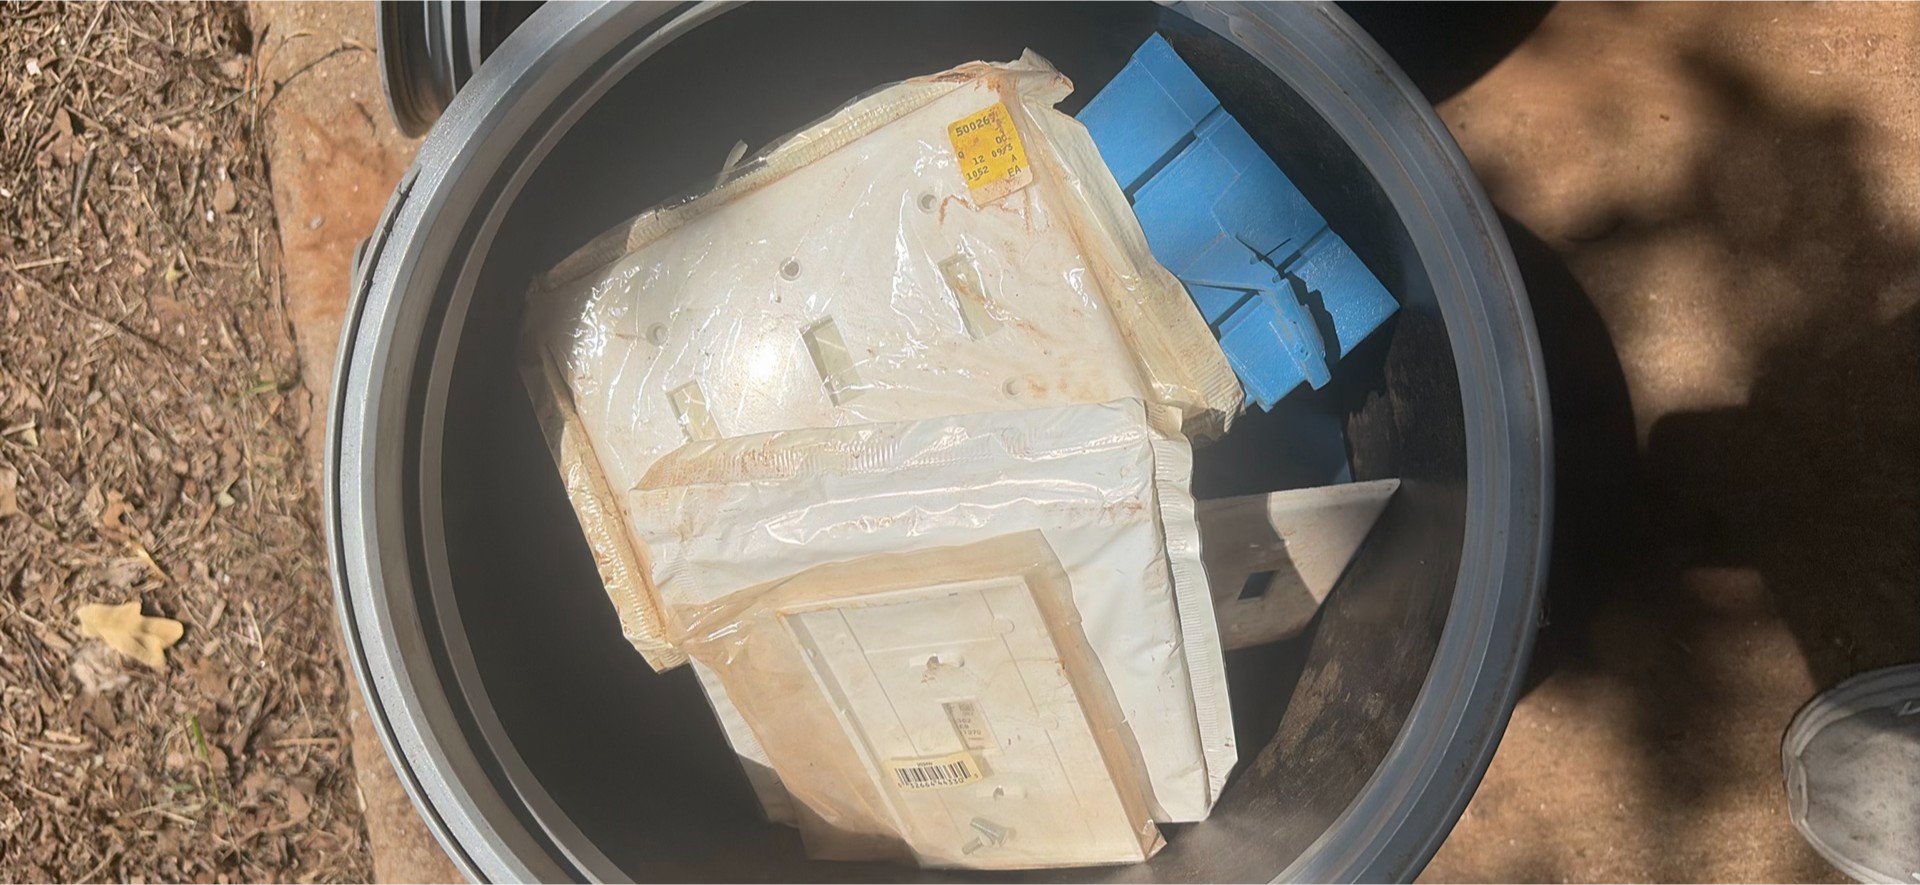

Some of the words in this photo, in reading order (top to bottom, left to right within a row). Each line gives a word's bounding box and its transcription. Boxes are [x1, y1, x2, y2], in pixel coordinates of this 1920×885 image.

[972, 155, 985, 166] 12
[966, 165, 990, 181] 1052
[1007, 164, 1022, 178] EA
